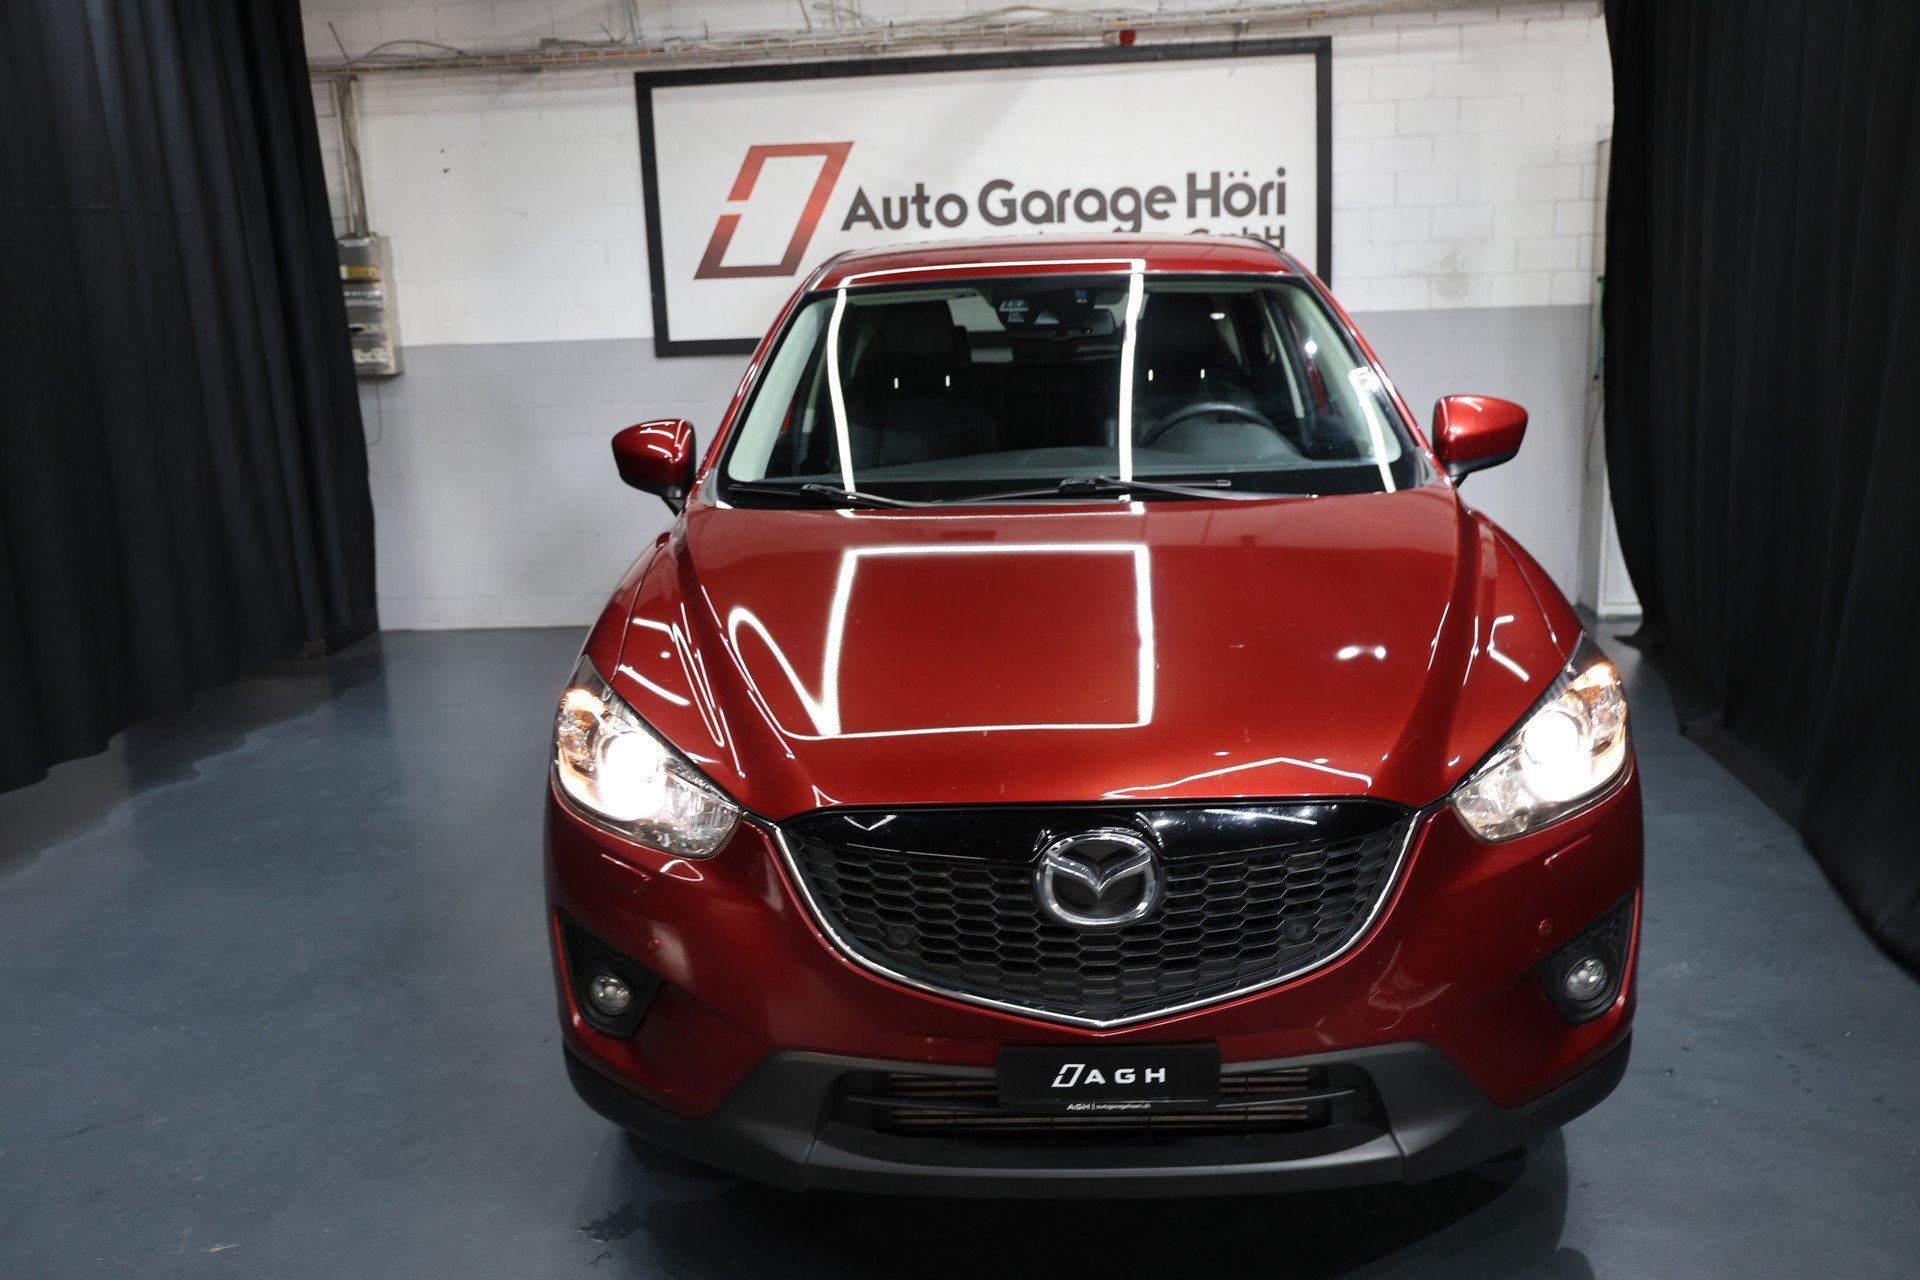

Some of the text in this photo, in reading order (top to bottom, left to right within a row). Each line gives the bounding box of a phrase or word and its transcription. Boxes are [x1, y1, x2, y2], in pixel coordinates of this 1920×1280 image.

[841, 167, 1286, 233] Auto Garage Höri
[1084, 1068, 1166, 1084] AGH
[1066, 1103, 1091, 1111] AGH
